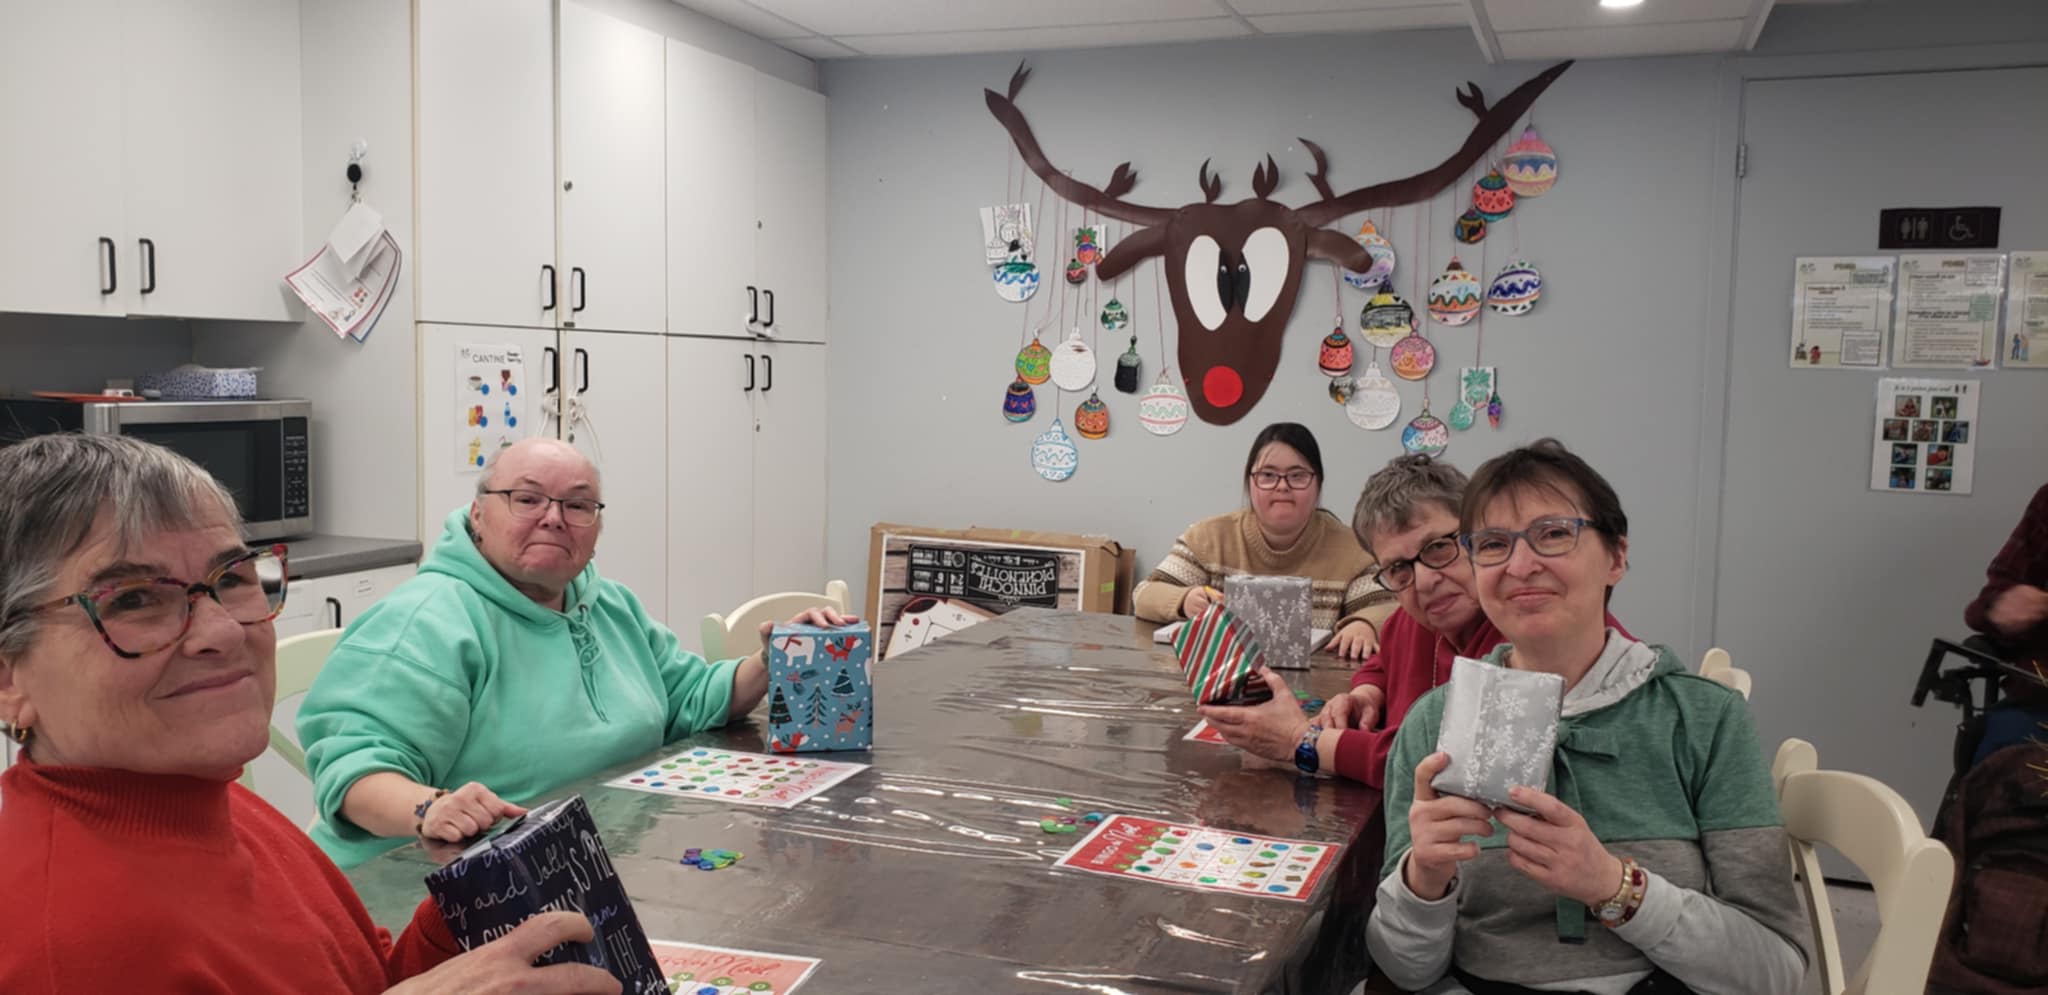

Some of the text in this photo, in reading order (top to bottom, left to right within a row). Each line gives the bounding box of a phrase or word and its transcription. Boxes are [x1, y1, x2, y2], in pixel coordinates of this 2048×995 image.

[472, 353, 505, 364] CANTINE
[970, 560, 1055, 582] PICHENOTTES
[979, 575, 1047, 596] PINNOCHI
[474, 872, 528, 910] and
[606, 924, 642, 978] THE
